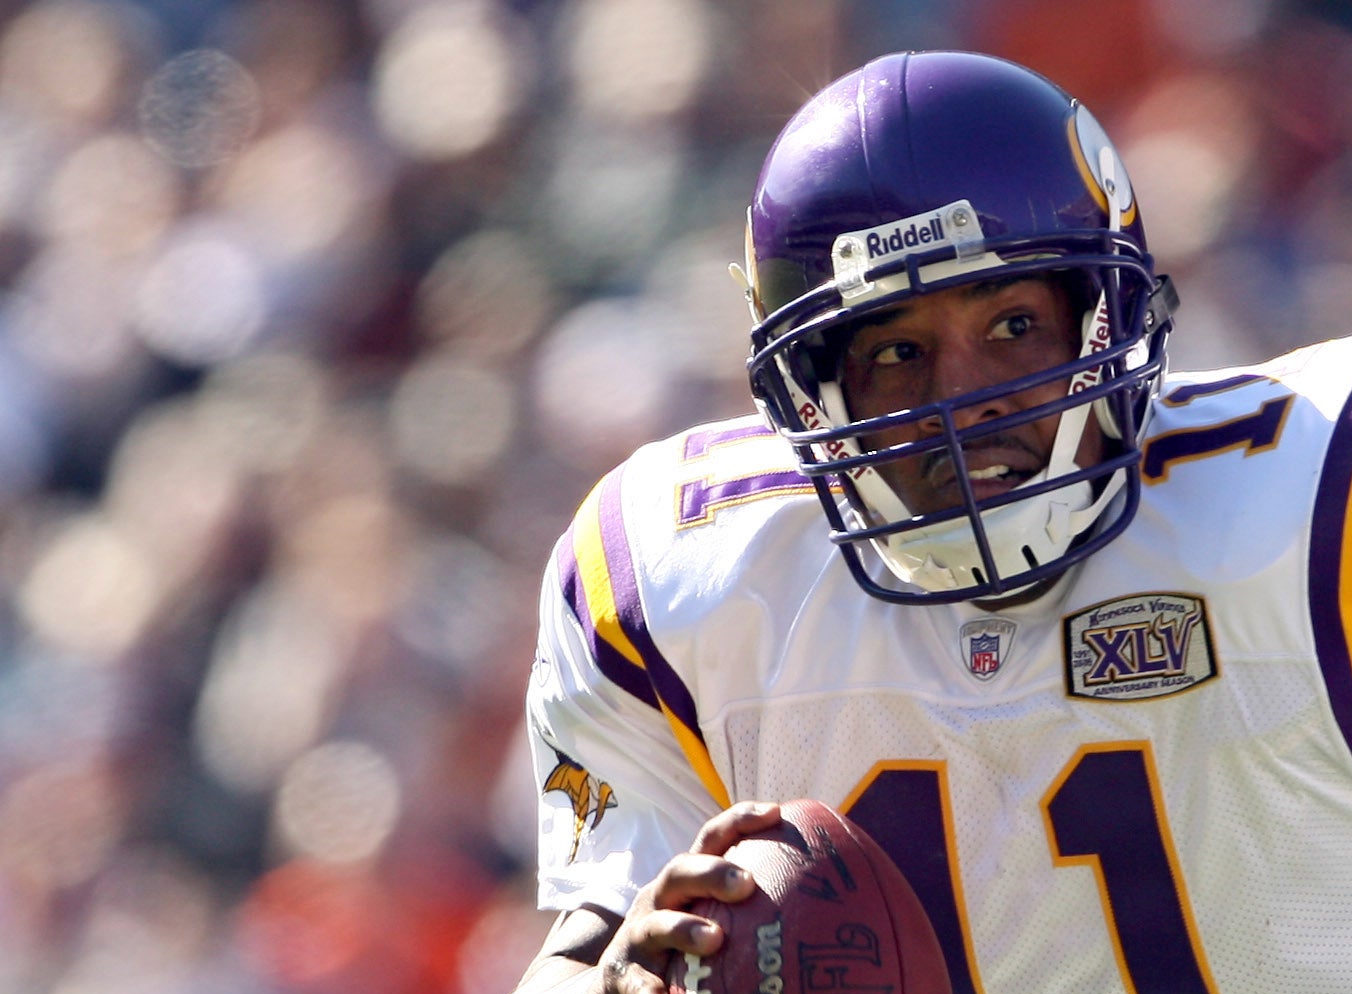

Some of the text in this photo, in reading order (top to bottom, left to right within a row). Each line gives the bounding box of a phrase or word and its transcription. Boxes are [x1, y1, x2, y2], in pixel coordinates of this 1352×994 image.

[866, 216, 945, 259] Riddell
[1073, 308, 1110, 394] Ridell
[971, 651, 999, 674] NFL
[1083, 600, 1203, 687] XLV
